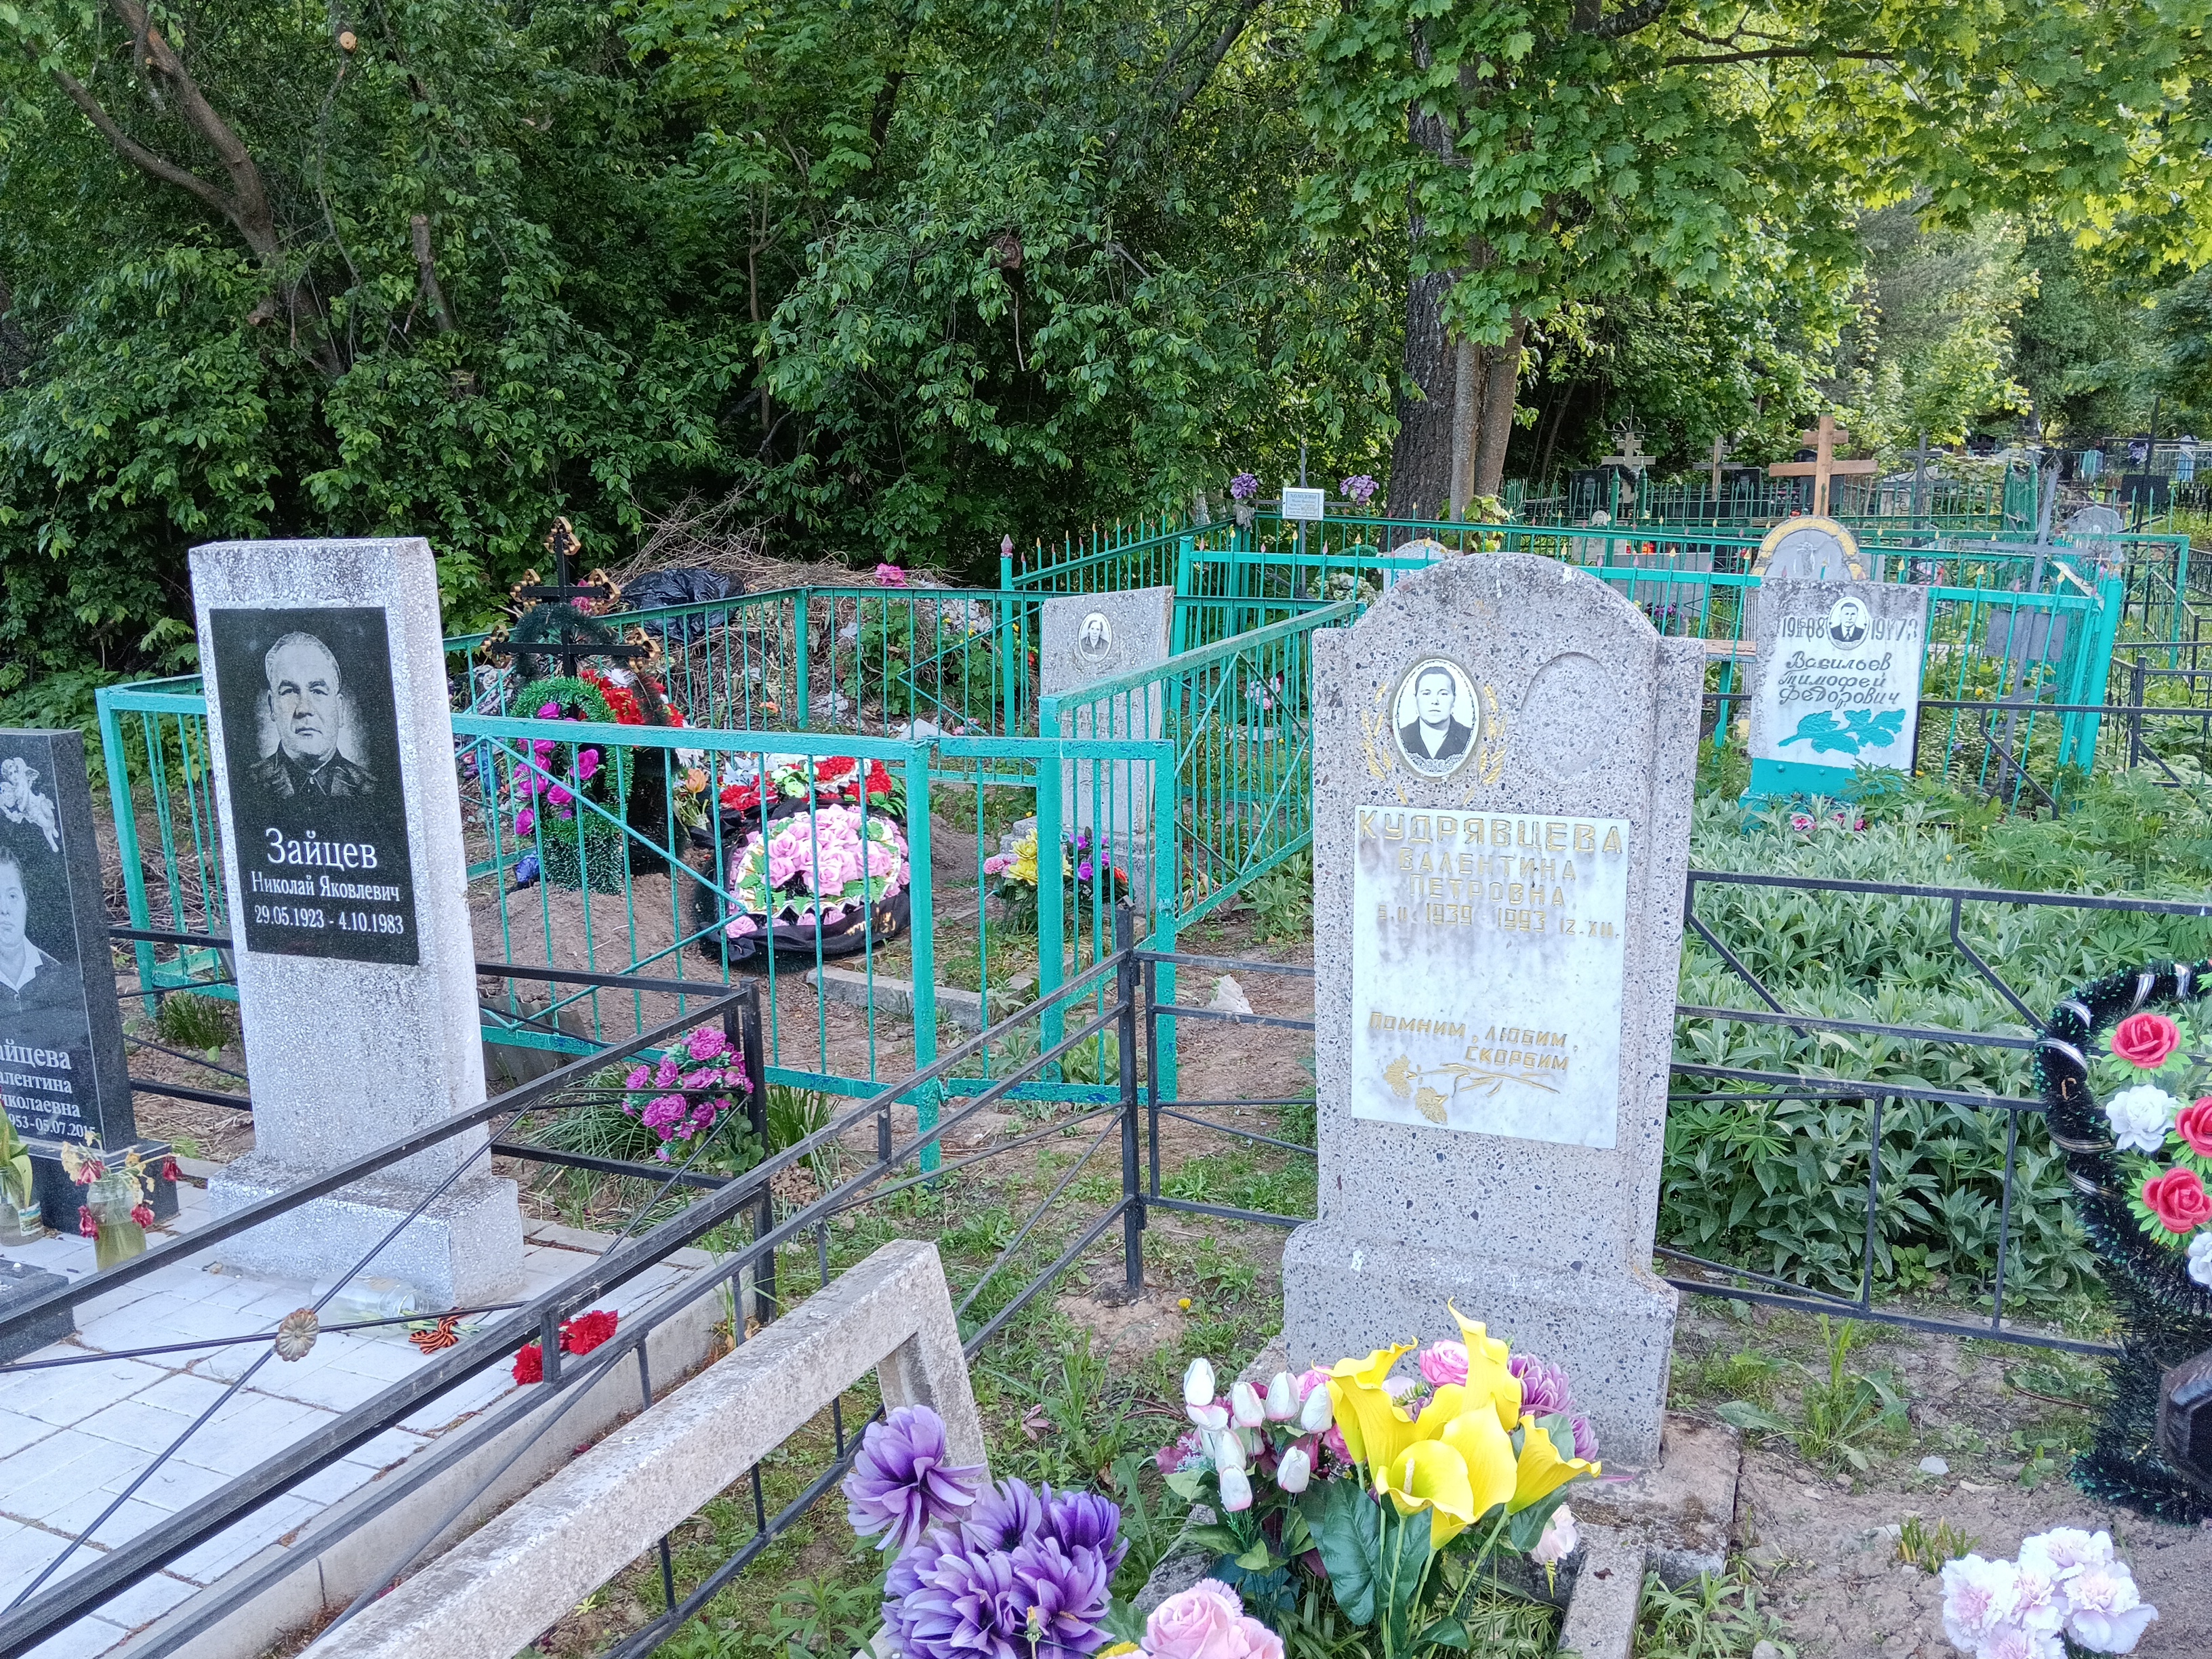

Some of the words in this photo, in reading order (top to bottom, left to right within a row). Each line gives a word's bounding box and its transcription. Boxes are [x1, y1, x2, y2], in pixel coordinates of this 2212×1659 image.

[1786, 651, 1892, 671] Васильев
[1778, 668, 1887, 692] Тимофей
[1779, 685, 1900, 710] Федорович
[1359, 810, 1623, 855] КУДРЯВЦЕВА
[265, 828, 378, 872] Зайцев
[1398, 848, 1577, 881] ВАЛЕНТИНА
[251, 871, 315, 896] Николай
[320, 876, 401, 902] Яковлевич
[1409, 874, 1565, 907] ПЕТРОВНА
[254, 905, 325, 928] 29.05.1923
[338, 911, 404, 935] 4.10.1983
[1426, 903, 1473, 926] 1939
[1498, 907, 1546, 933] 1993
[1465, 1045, 1570, 1070] СКОРБИМ
